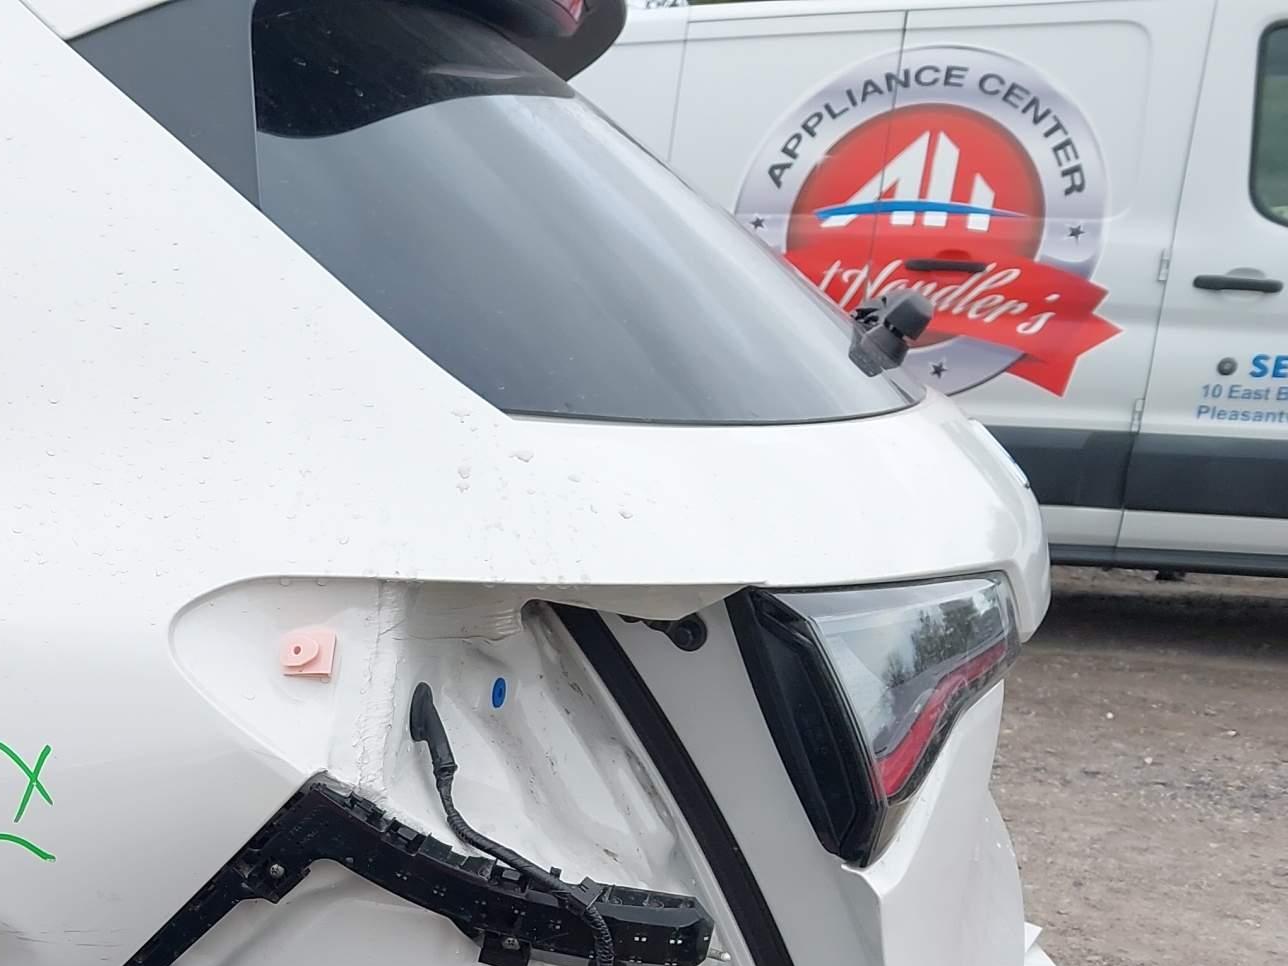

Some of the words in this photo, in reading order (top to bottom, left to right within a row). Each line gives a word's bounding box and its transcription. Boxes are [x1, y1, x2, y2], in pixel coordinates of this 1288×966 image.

[767, 65, 970, 189] APPLIANCE
[978, 72, 1087, 196] CENTER
[1202, 384, 1223, 398] 10
[1228, 384, 1271, 400] East
